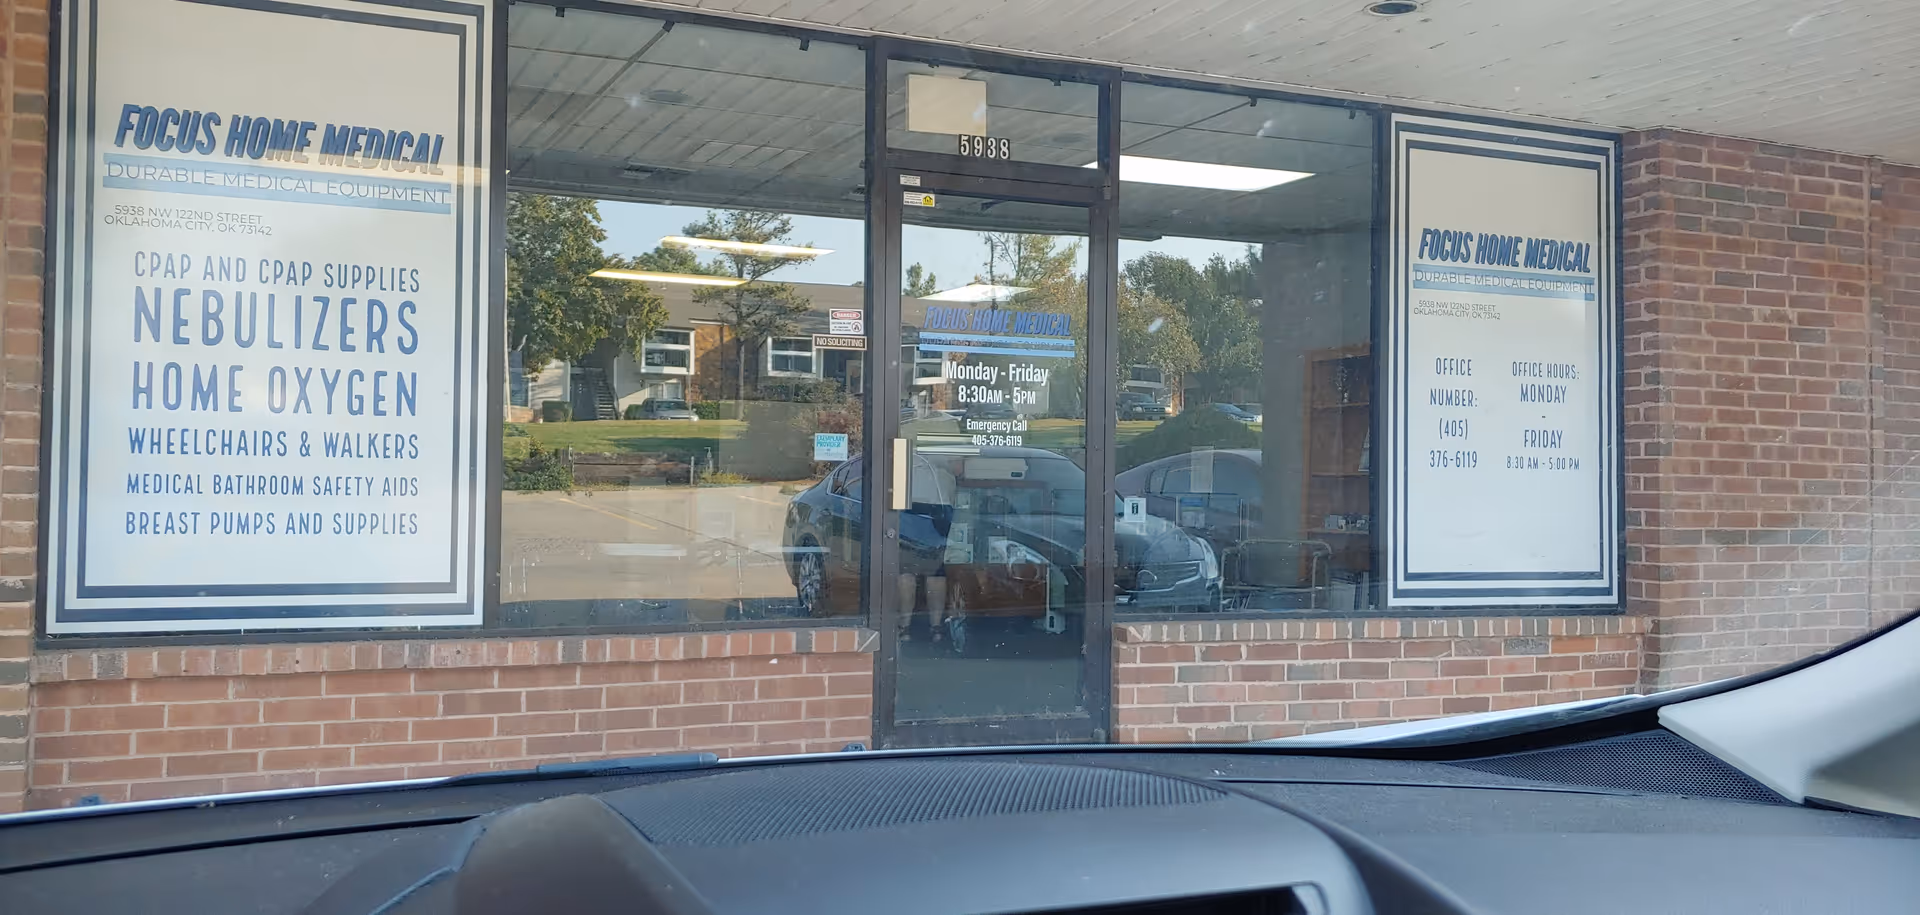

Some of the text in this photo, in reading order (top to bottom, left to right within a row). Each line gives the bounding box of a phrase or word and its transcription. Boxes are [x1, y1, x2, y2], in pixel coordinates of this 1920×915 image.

[113, 103, 445, 176] FOCUS HOME MEDICAL
[960, 135, 1009, 159] 5938
[107, 161, 450, 204] DURABLE MEDICAL EQUIPMENT
[104, 214, 182, 230] OKLAHOMA
[217, 221, 237, 234] OK
[239, 223, 272, 236] 73142
[114, 204, 263, 225] 5938 NW 122ND STREET
[1418, 228, 1591, 273] FOCUS HOME MEDICAL
[134, 250, 420, 293] CPAP AND CPAP SUPPLIES
[1415, 269, 1594, 294] DURABLE MEDICAL EQUIPMENT
[1413, 307, 1454, 317] OKLAHOMA
[1471, 311, 1483, 320] OK
[1483, 312, 1501, 320] 73142
[1418, 300, 1435, 308] 5938
[1436, 301, 1449, 309] NW
[1471, 303, 1496, 312] STREET
[133, 285, 419, 355] NEBULIZERS
[924, 306, 1072, 336] FOCUS HOME MEDICAL
[816, 337, 863, 347] NO SOLICITING
[945, 361, 998, 385] Monday
[1009, 363, 1048, 386] Friday
[1435, 357, 1472, 377] OFFICE
[1512, 361, 1580, 380] OFFICE HOURS:
[132, 360, 417, 416] HOME OXYGEN
[958, 385, 1002, 403] 8:30AM
[1013, 387, 1036, 405] 5PM
[1430, 388, 1478, 408] NUMBER:
[1520, 383, 1567, 404] MONDAY
[966, 418, 1027, 433] Emergency Call
[1438, 418, 1469, 440] (405)
[128, 427, 419, 459] WHEELCHAIRS & WALKERS
[972, 435, 1022, 446] 405-376-6119
[1524, 429, 1563, 449] FRIDAY
[1429, 450, 1478, 468] 376-6119
[1506, 456, 1524, 470] 8:30
[1527, 456, 1539, 470] AM
[1548, 457, 1566, 470] 5:00
[1569, 457, 1580, 471] PM
[126, 473, 419, 497] MEDICAL BATHROOM SAFETY AIDS
[126, 511, 418, 535] BREAST PUMPS AND SUPPLIES
